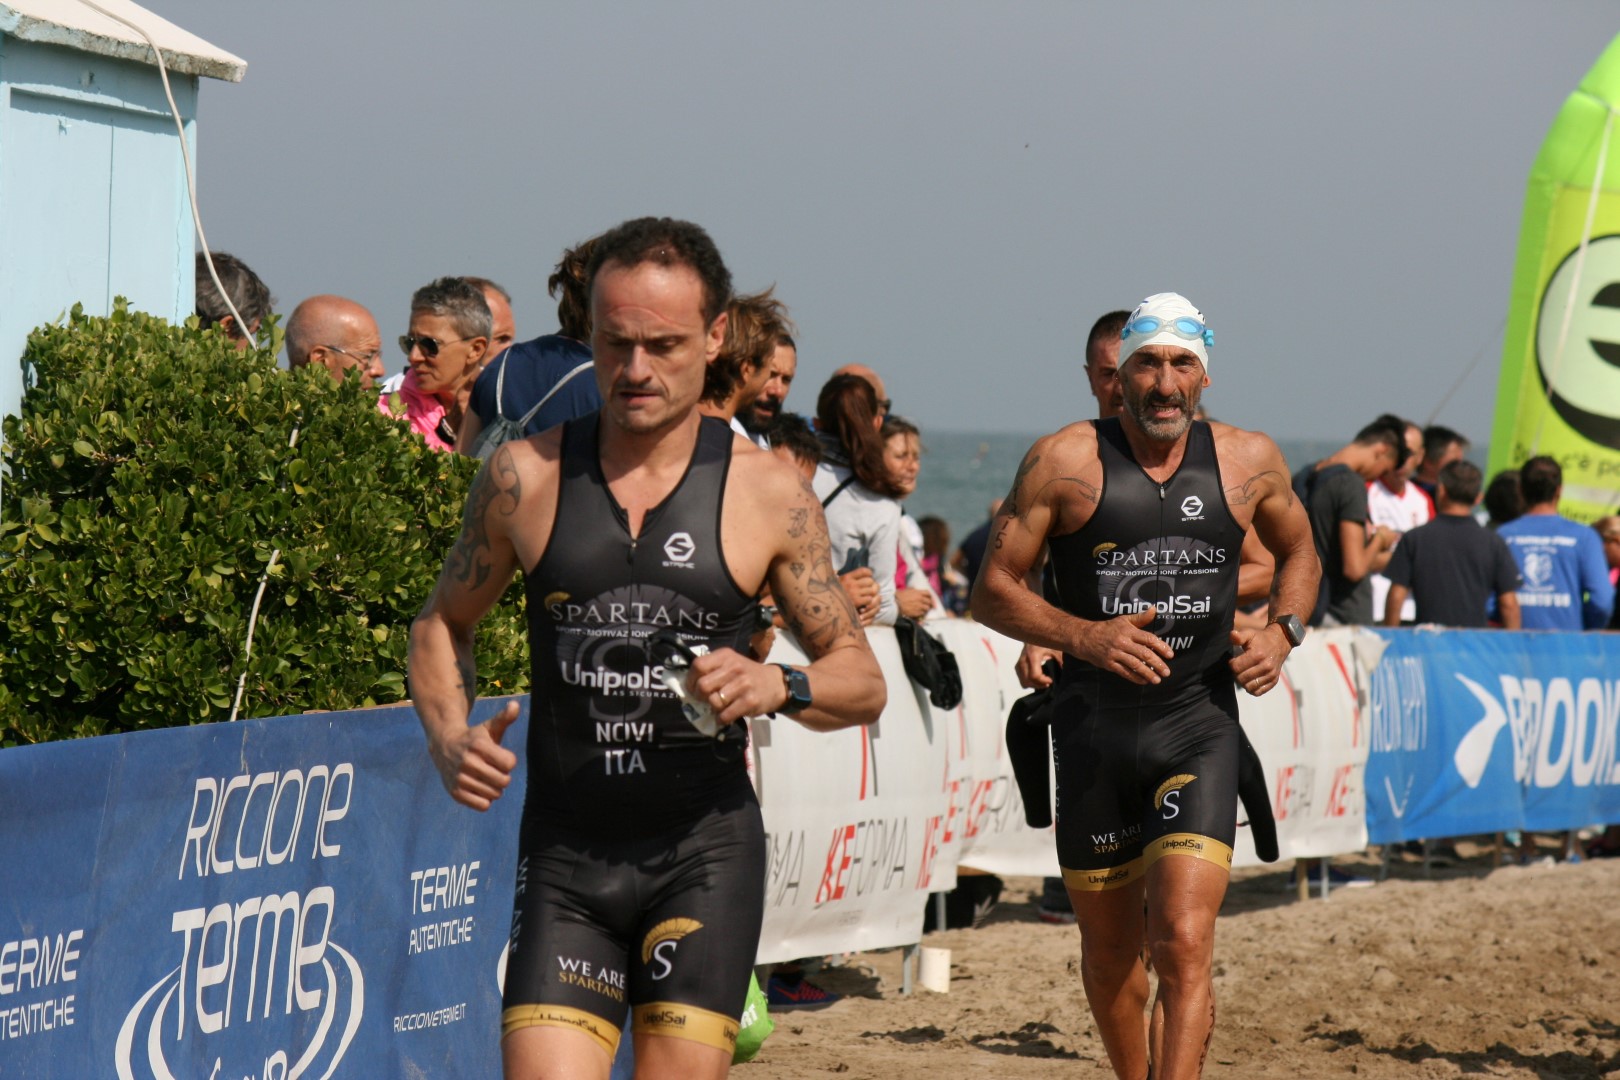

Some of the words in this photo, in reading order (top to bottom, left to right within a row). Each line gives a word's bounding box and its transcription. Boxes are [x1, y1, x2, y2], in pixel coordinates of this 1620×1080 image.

[1097, 548, 1226, 566] SPARTANS
[551, 602, 719, 629] SPARTANS
[596, 722, 653, 743] NOVI
[1499, 674, 1620, 788] BROOK
[605, 749, 646, 775] ITA
[1091, 832, 1116, 845] WE
[410, 861, 480, 914] TERME
[408, 916, 474, 956] AUTENTICHE
[557, 955, 592, 977] WE
[597, 967, 626, 989] ARE
[558, 972, 624, 1003] SPARTANS
